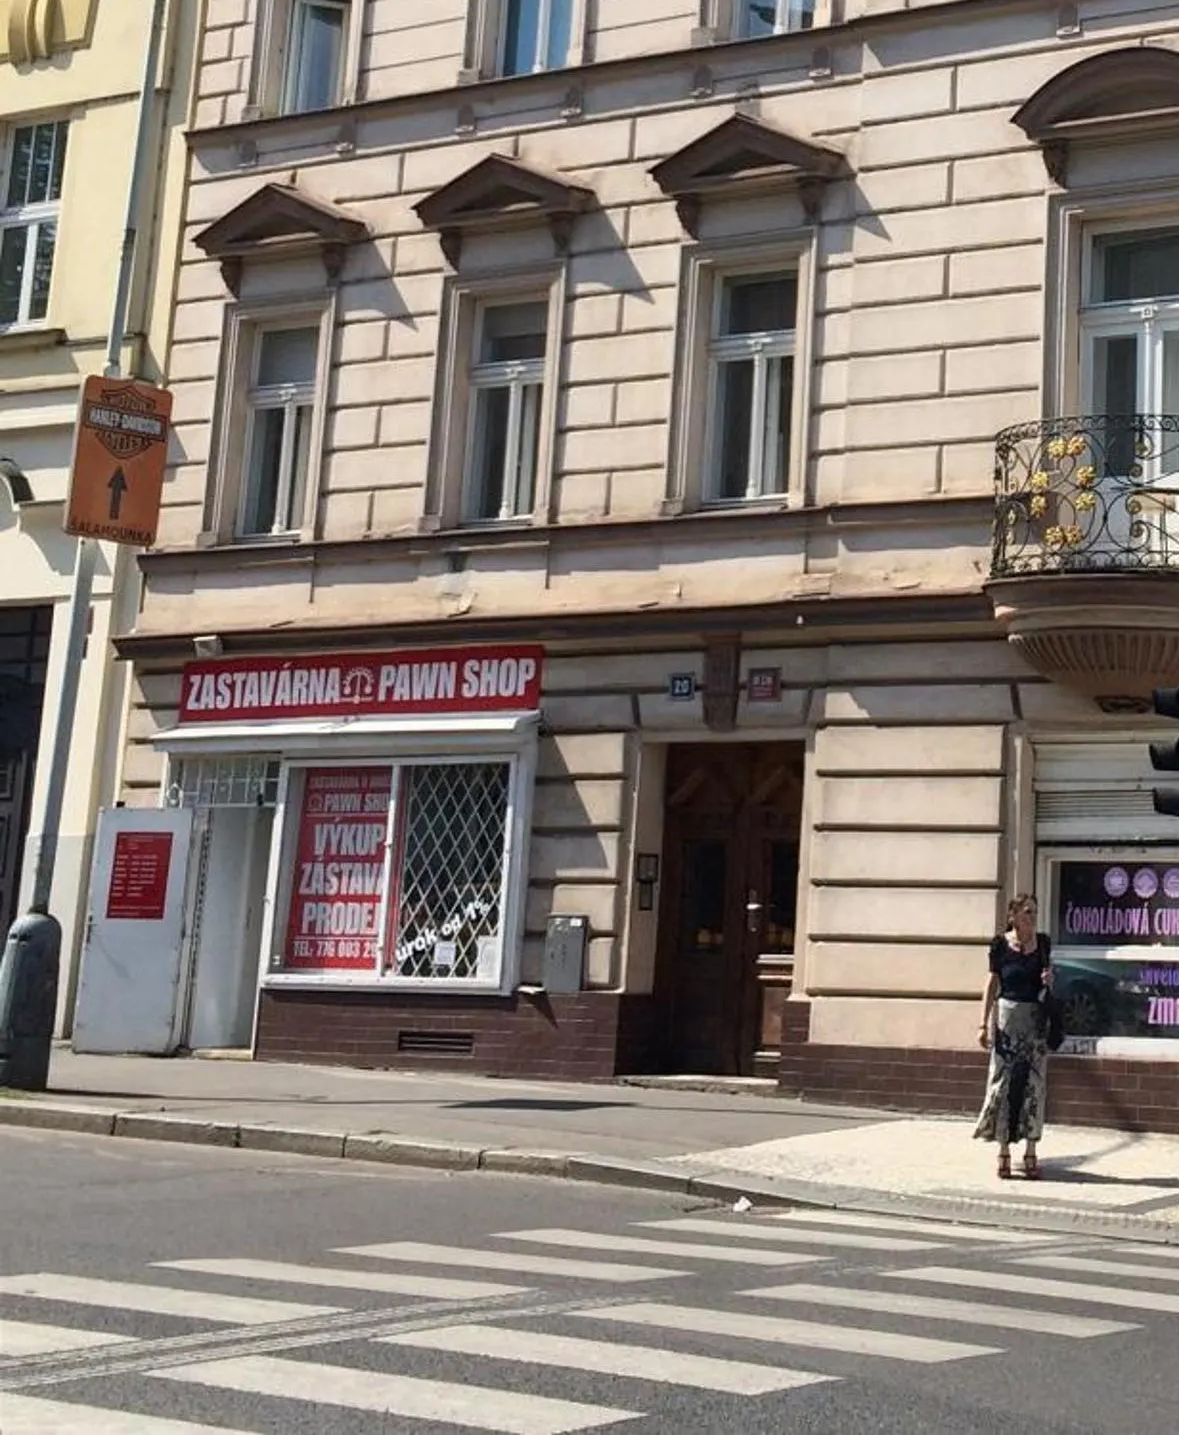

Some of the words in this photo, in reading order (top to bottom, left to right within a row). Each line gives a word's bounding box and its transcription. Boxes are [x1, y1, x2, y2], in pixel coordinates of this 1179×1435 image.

[186, 662, 341, 711] ZASTAVÁRNA
[377, 660, 458, 703] PAWN
[461, 657, 536, 698] SHOP
[324, 793, 362, 812] PAWN
[313, 816, 386, 856] VÝKUP
[441, 913, 462, 936] od
[1065, 900, 1150, 935] ČOKOLÁDOVÁ
